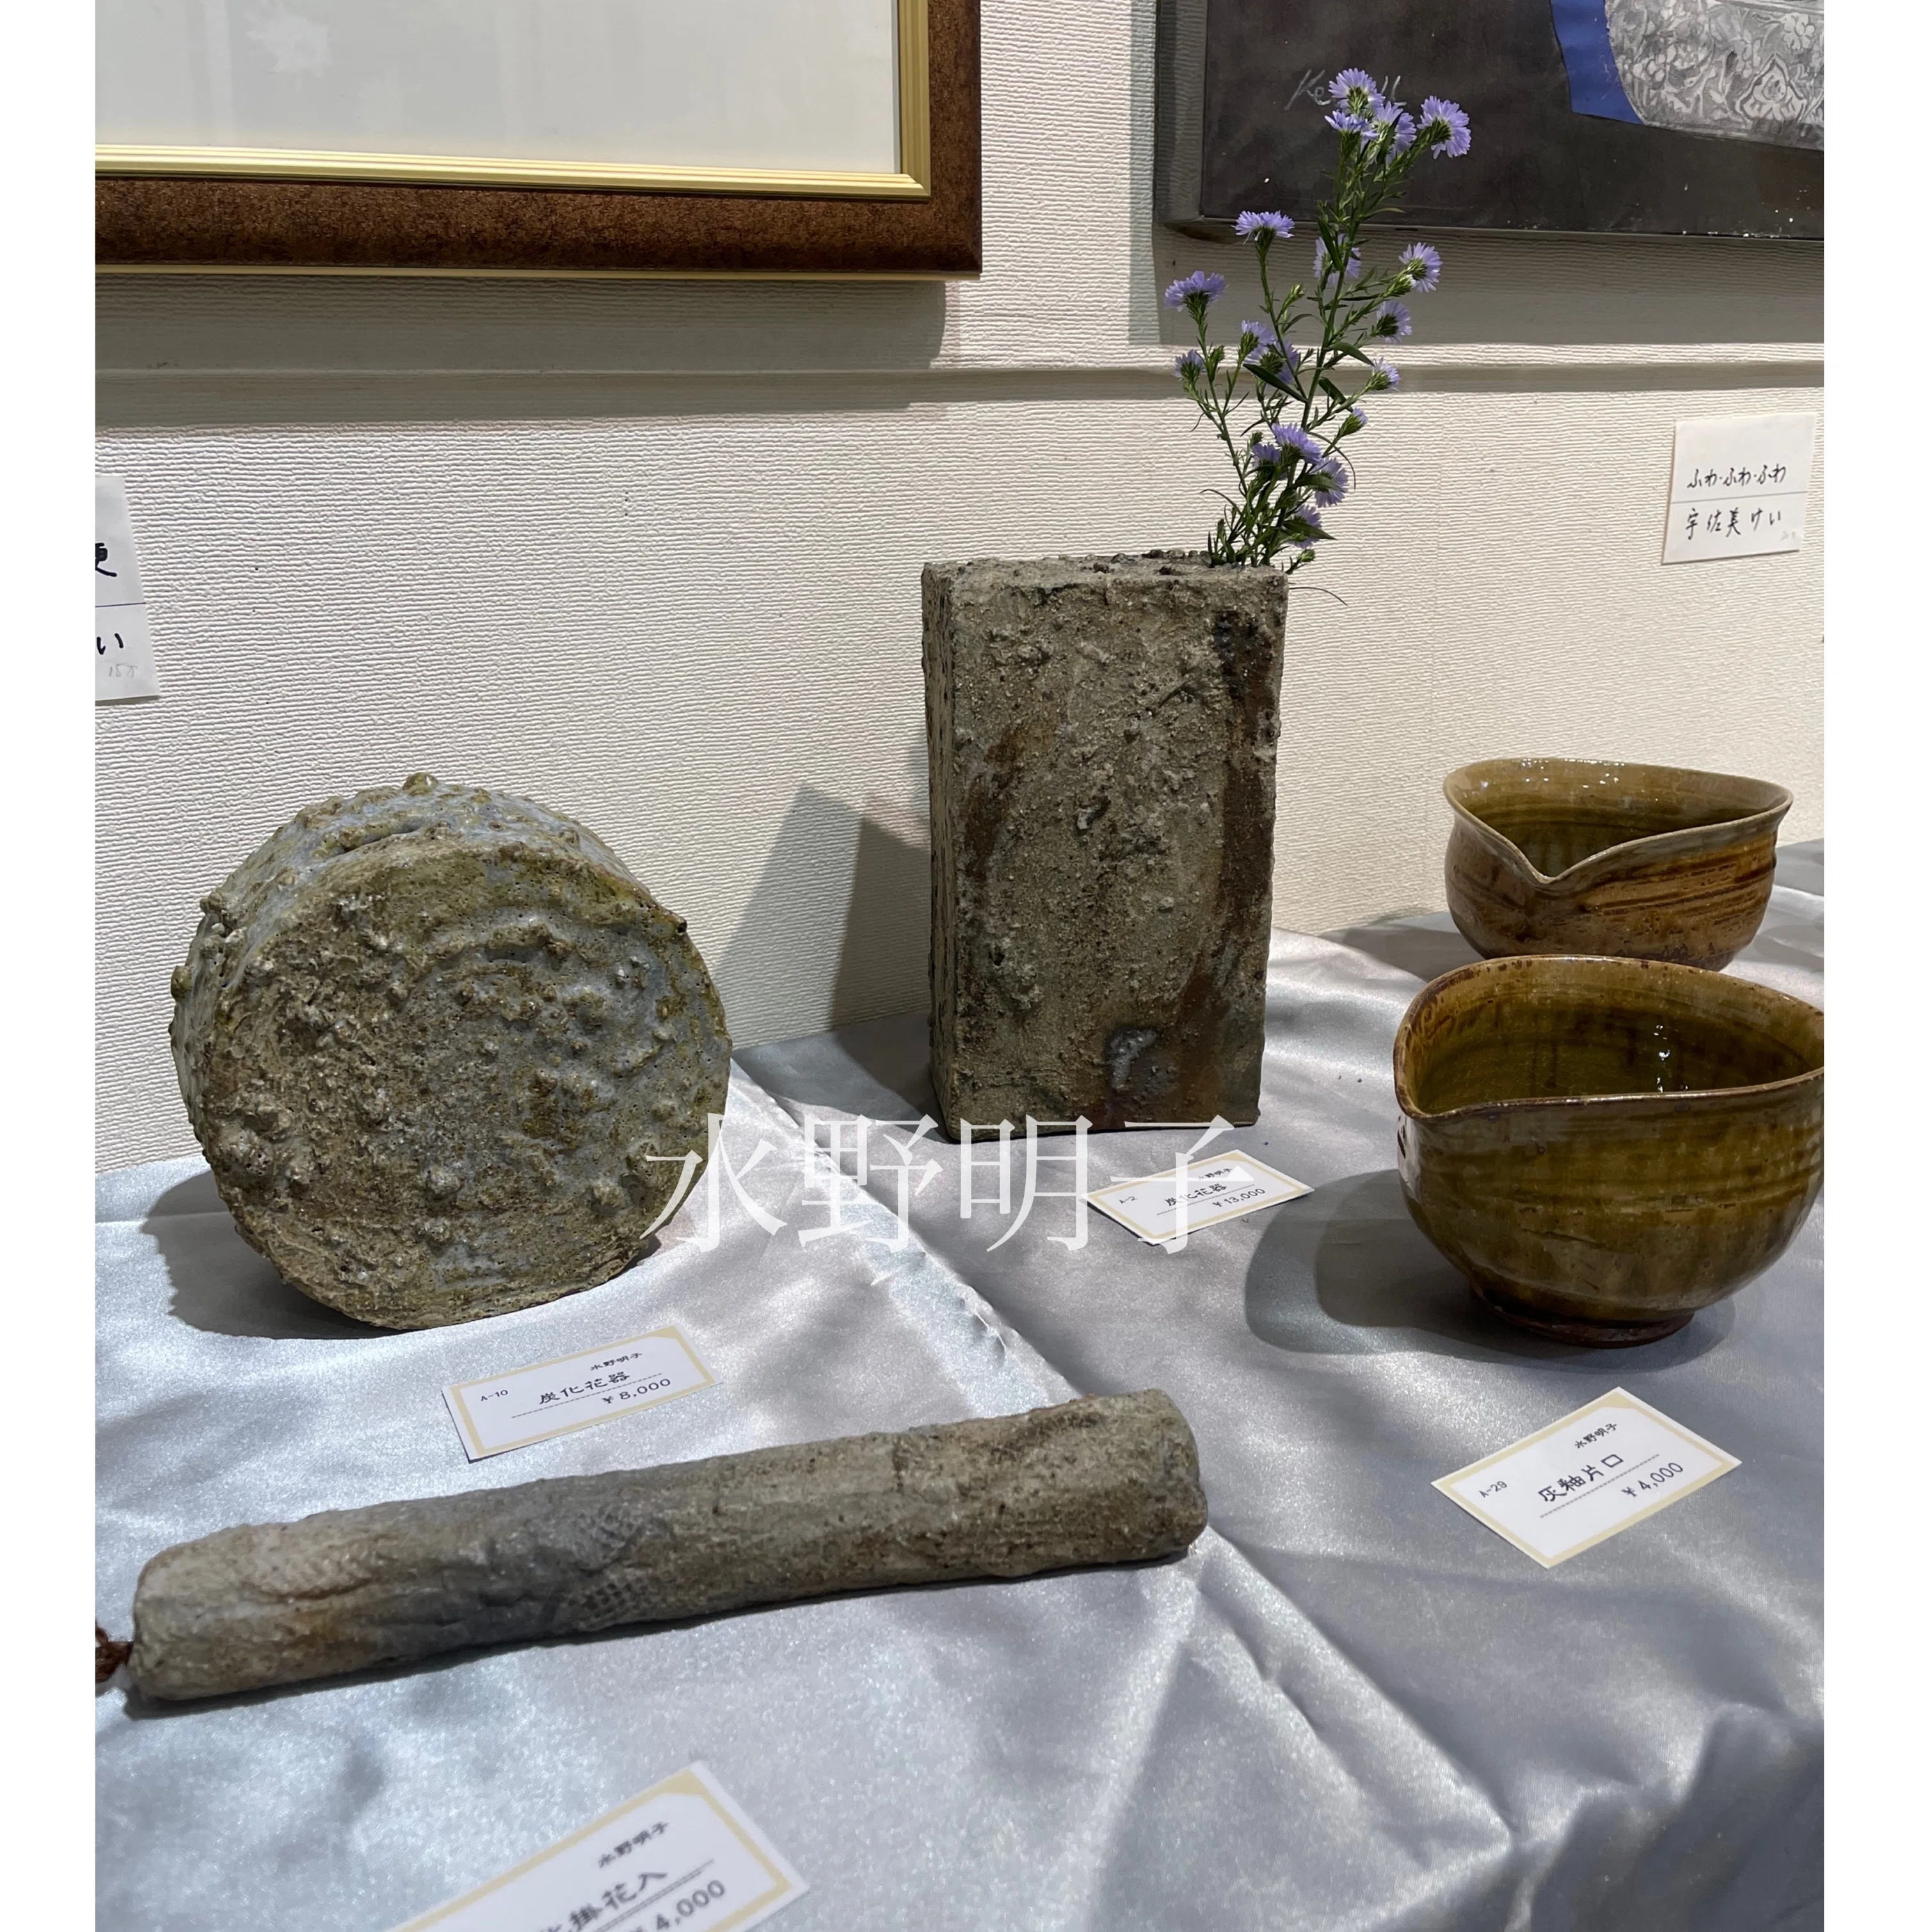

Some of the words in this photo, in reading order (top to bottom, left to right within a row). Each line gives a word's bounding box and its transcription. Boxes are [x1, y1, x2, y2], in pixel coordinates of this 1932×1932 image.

[590, 1352, 643, 1371] 水野明子
[481, 1389, 509, 1401] A-10
[539, 1371, 631, 1405] 炭化花器
[1574, 1422, 1618, 1449] 水野明子
[1479, 1481, 1508, 1498] A-29
[1538, 1453, 1624, 1502] 灰釉片口
[598, 1821, 668, 1869] 水野明子
[628, 1880, 726, 1932] 4,000
